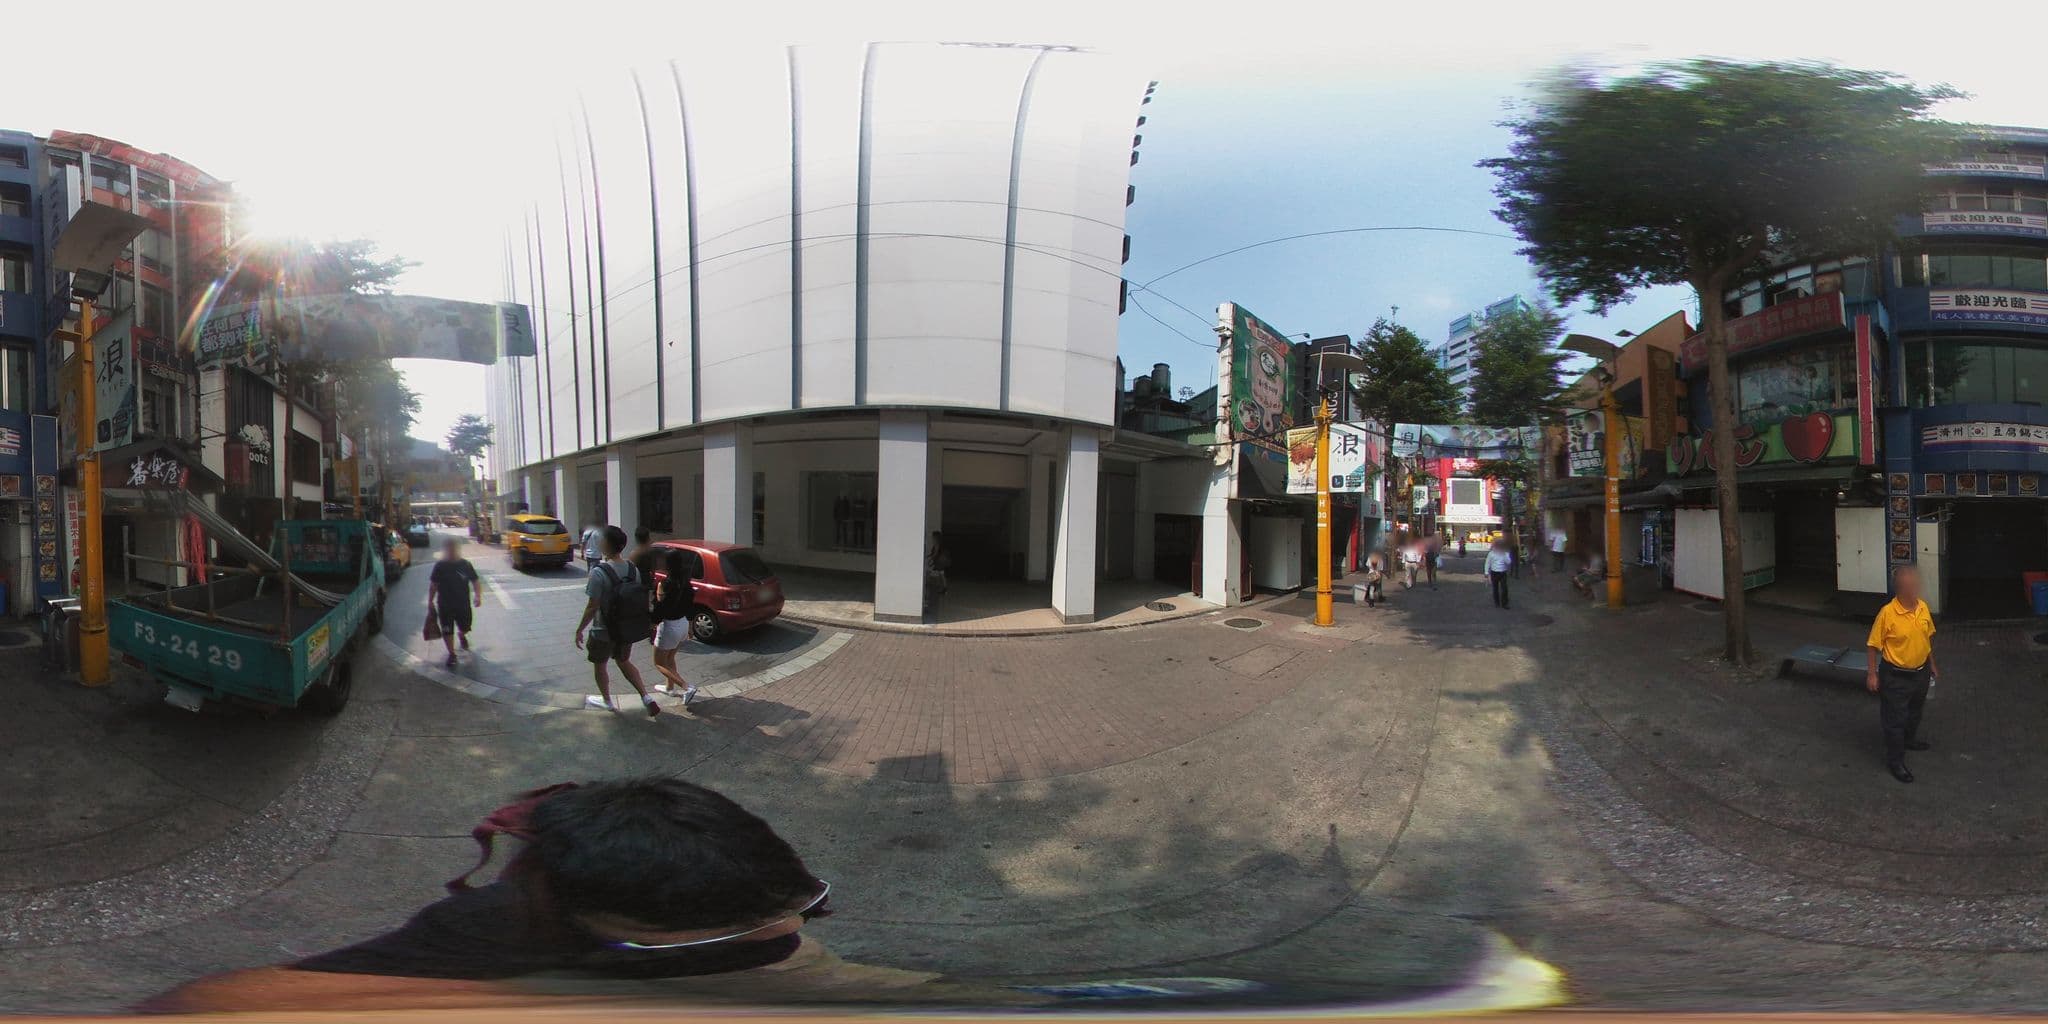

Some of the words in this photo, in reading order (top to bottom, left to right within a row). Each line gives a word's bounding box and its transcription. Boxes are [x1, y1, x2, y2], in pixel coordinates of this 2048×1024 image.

[1950, 214, 2023, 224] 歡迎光臨
[1955, 294, 2026, 309] 歡迎光臨
[97, 336, 123, 384] 浪
[1333, 433, 1358, 456] 浪
[1319, 499, 1325, 507] H
